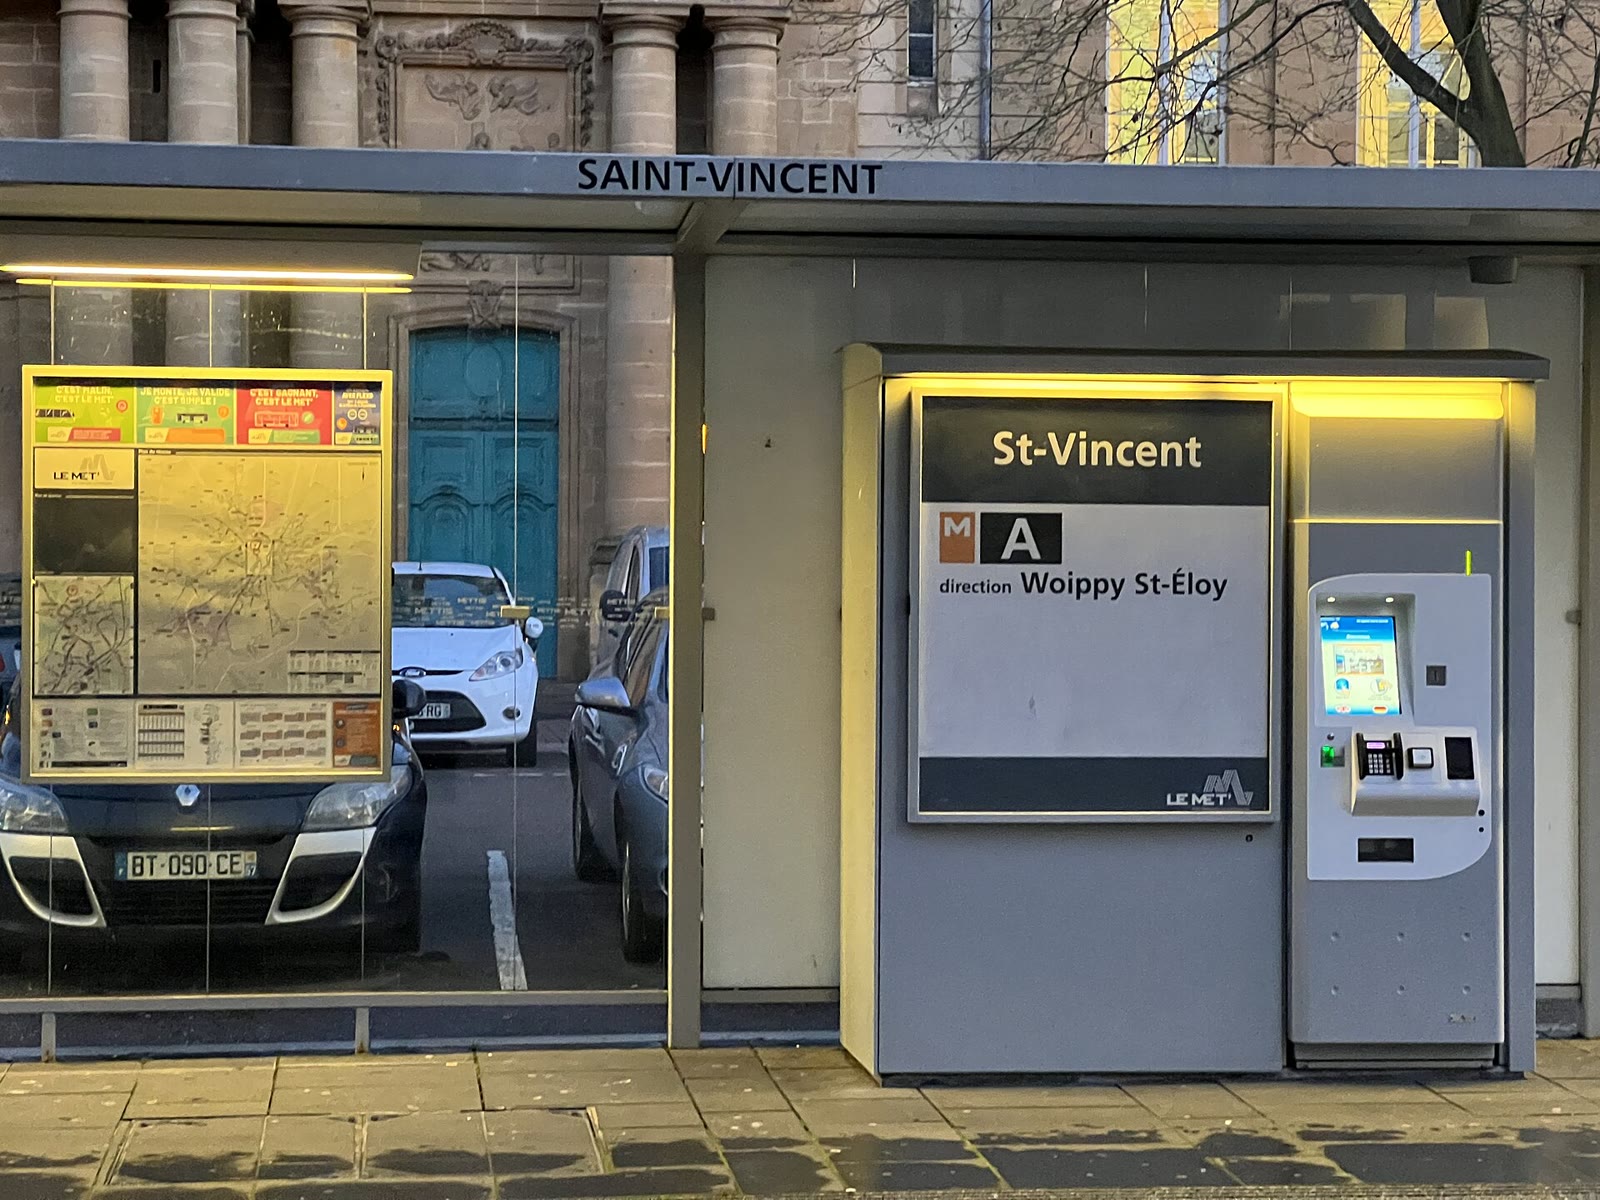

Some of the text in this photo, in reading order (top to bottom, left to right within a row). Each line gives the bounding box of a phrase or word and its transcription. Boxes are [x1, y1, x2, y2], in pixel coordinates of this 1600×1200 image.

[577, 158, 883, 194] SAINT-VINCENT
[993, 430, 1202, 468] St-Vincent
[53, 471, 100, 480] LE MET'
[943, 516, 1042, 560] M A
[939, 567, 1228, 601] direction Woippy St-Éloy
[1166, 793, 1232, 806] LE MET'
